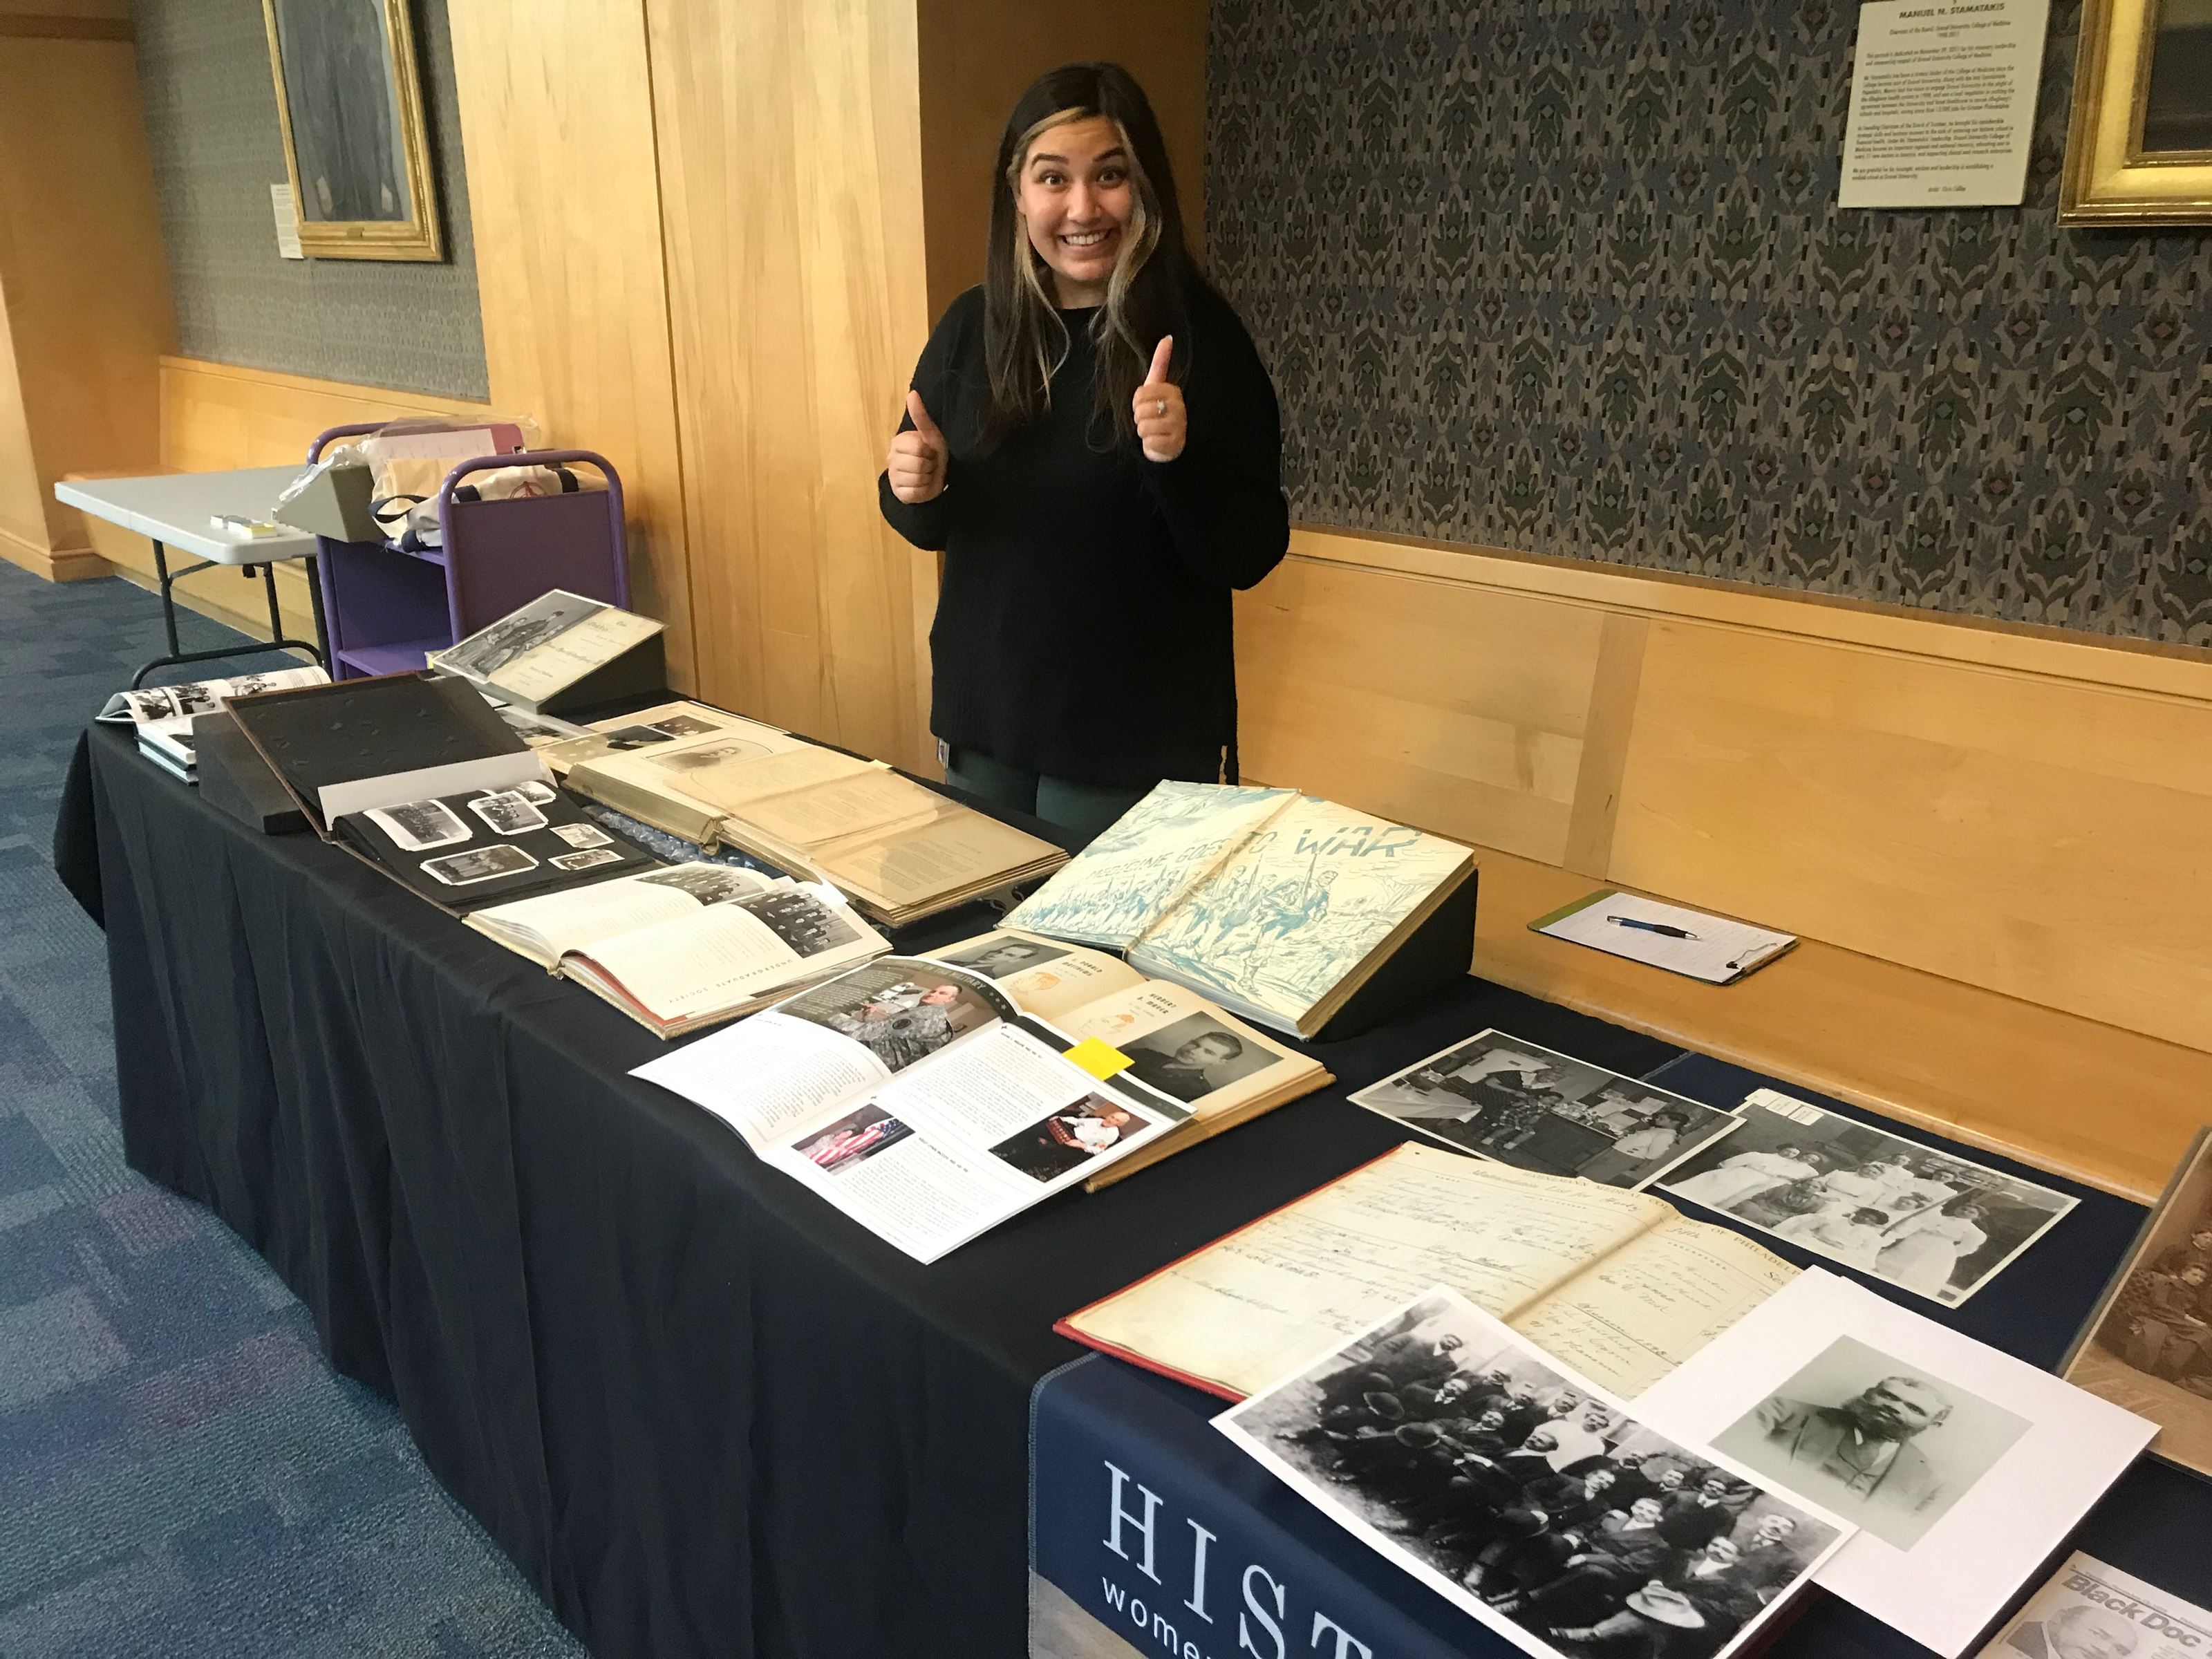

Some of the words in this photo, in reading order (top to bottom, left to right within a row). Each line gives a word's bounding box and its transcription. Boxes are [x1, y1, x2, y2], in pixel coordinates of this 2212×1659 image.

[1899, 8, 1935, 19] MANUEL
[1937, 8, 1947, 16] N.
[1950, 3, 2005, 15] STAMATAKIS
[1176, 838, 1232, 863] GOES
[1294, 826, 1423, 858] WAR
[716, 959, 793, 988] UNDERGRADUATE
[949, 971, 986, 990] MILITARY
[669, 987, 709, 1003] SOCIETY
[1149, 993, 1178, 1009] HERBERT
[1711, 1227, 1728, 1235] OF
[1102, 1576, 1211, 1659] wome
[2061, 1575, 2144, 1620] Black
[2140, 1611, 2212, 1658] Doc
